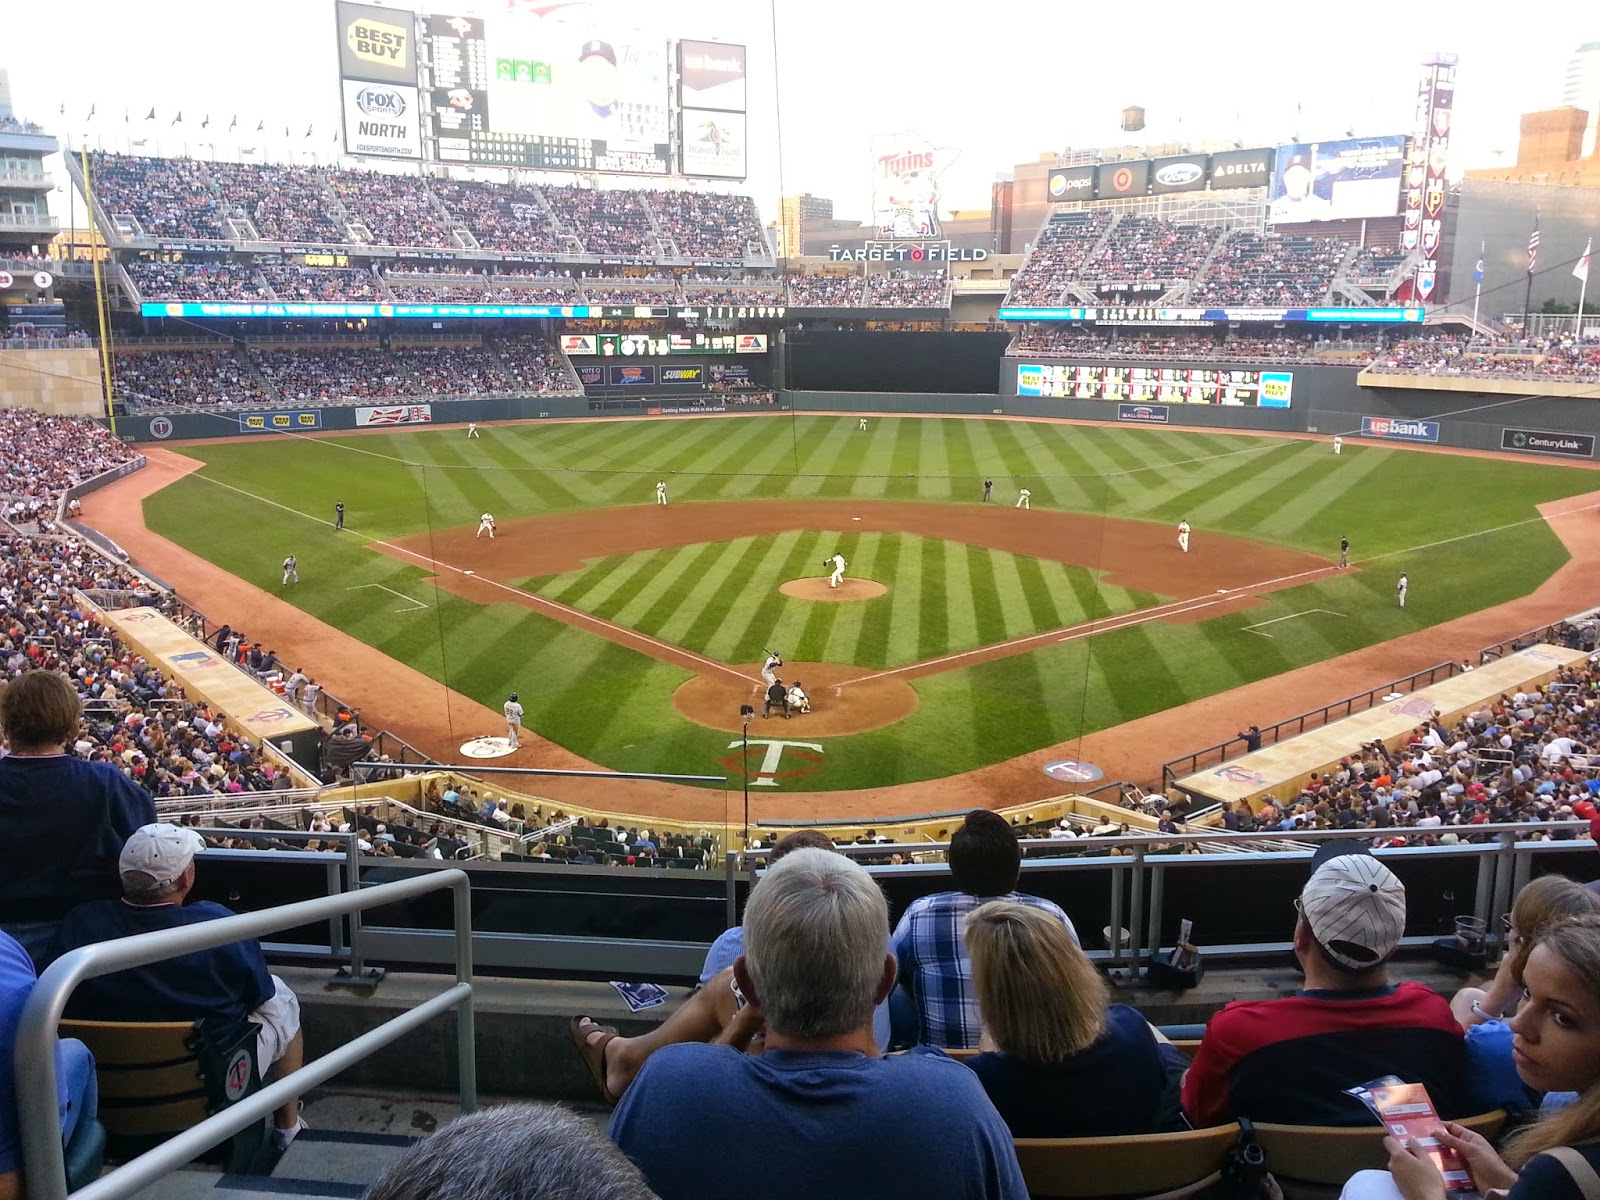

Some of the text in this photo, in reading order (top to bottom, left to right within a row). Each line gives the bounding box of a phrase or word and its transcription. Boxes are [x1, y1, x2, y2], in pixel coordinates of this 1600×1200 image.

[355, 26, 404, 48] BEST
[357, 40, 400, 59] BUY
[366, 92, 395, 108] FOX
[367, 106, 397, 114] SPORTS
[359, 121, 406, 138] NORTH
[356, 144, 412, 154] FOXSPORTSNORTH.COM
[878, 150, 933, 178] Twins
[1226, 162, 1266, 175] DELTA
[1164, 170, 1192, 182] Ford
[1066, 176, 1092, 190] pepsi
[829, 248, 988, 261] TARGET FIELD
[663, 369, 700, 379] SUBWAY
[155, 421, 167, 434] T
[1529, 436, 1578, 450] CenturyLink
